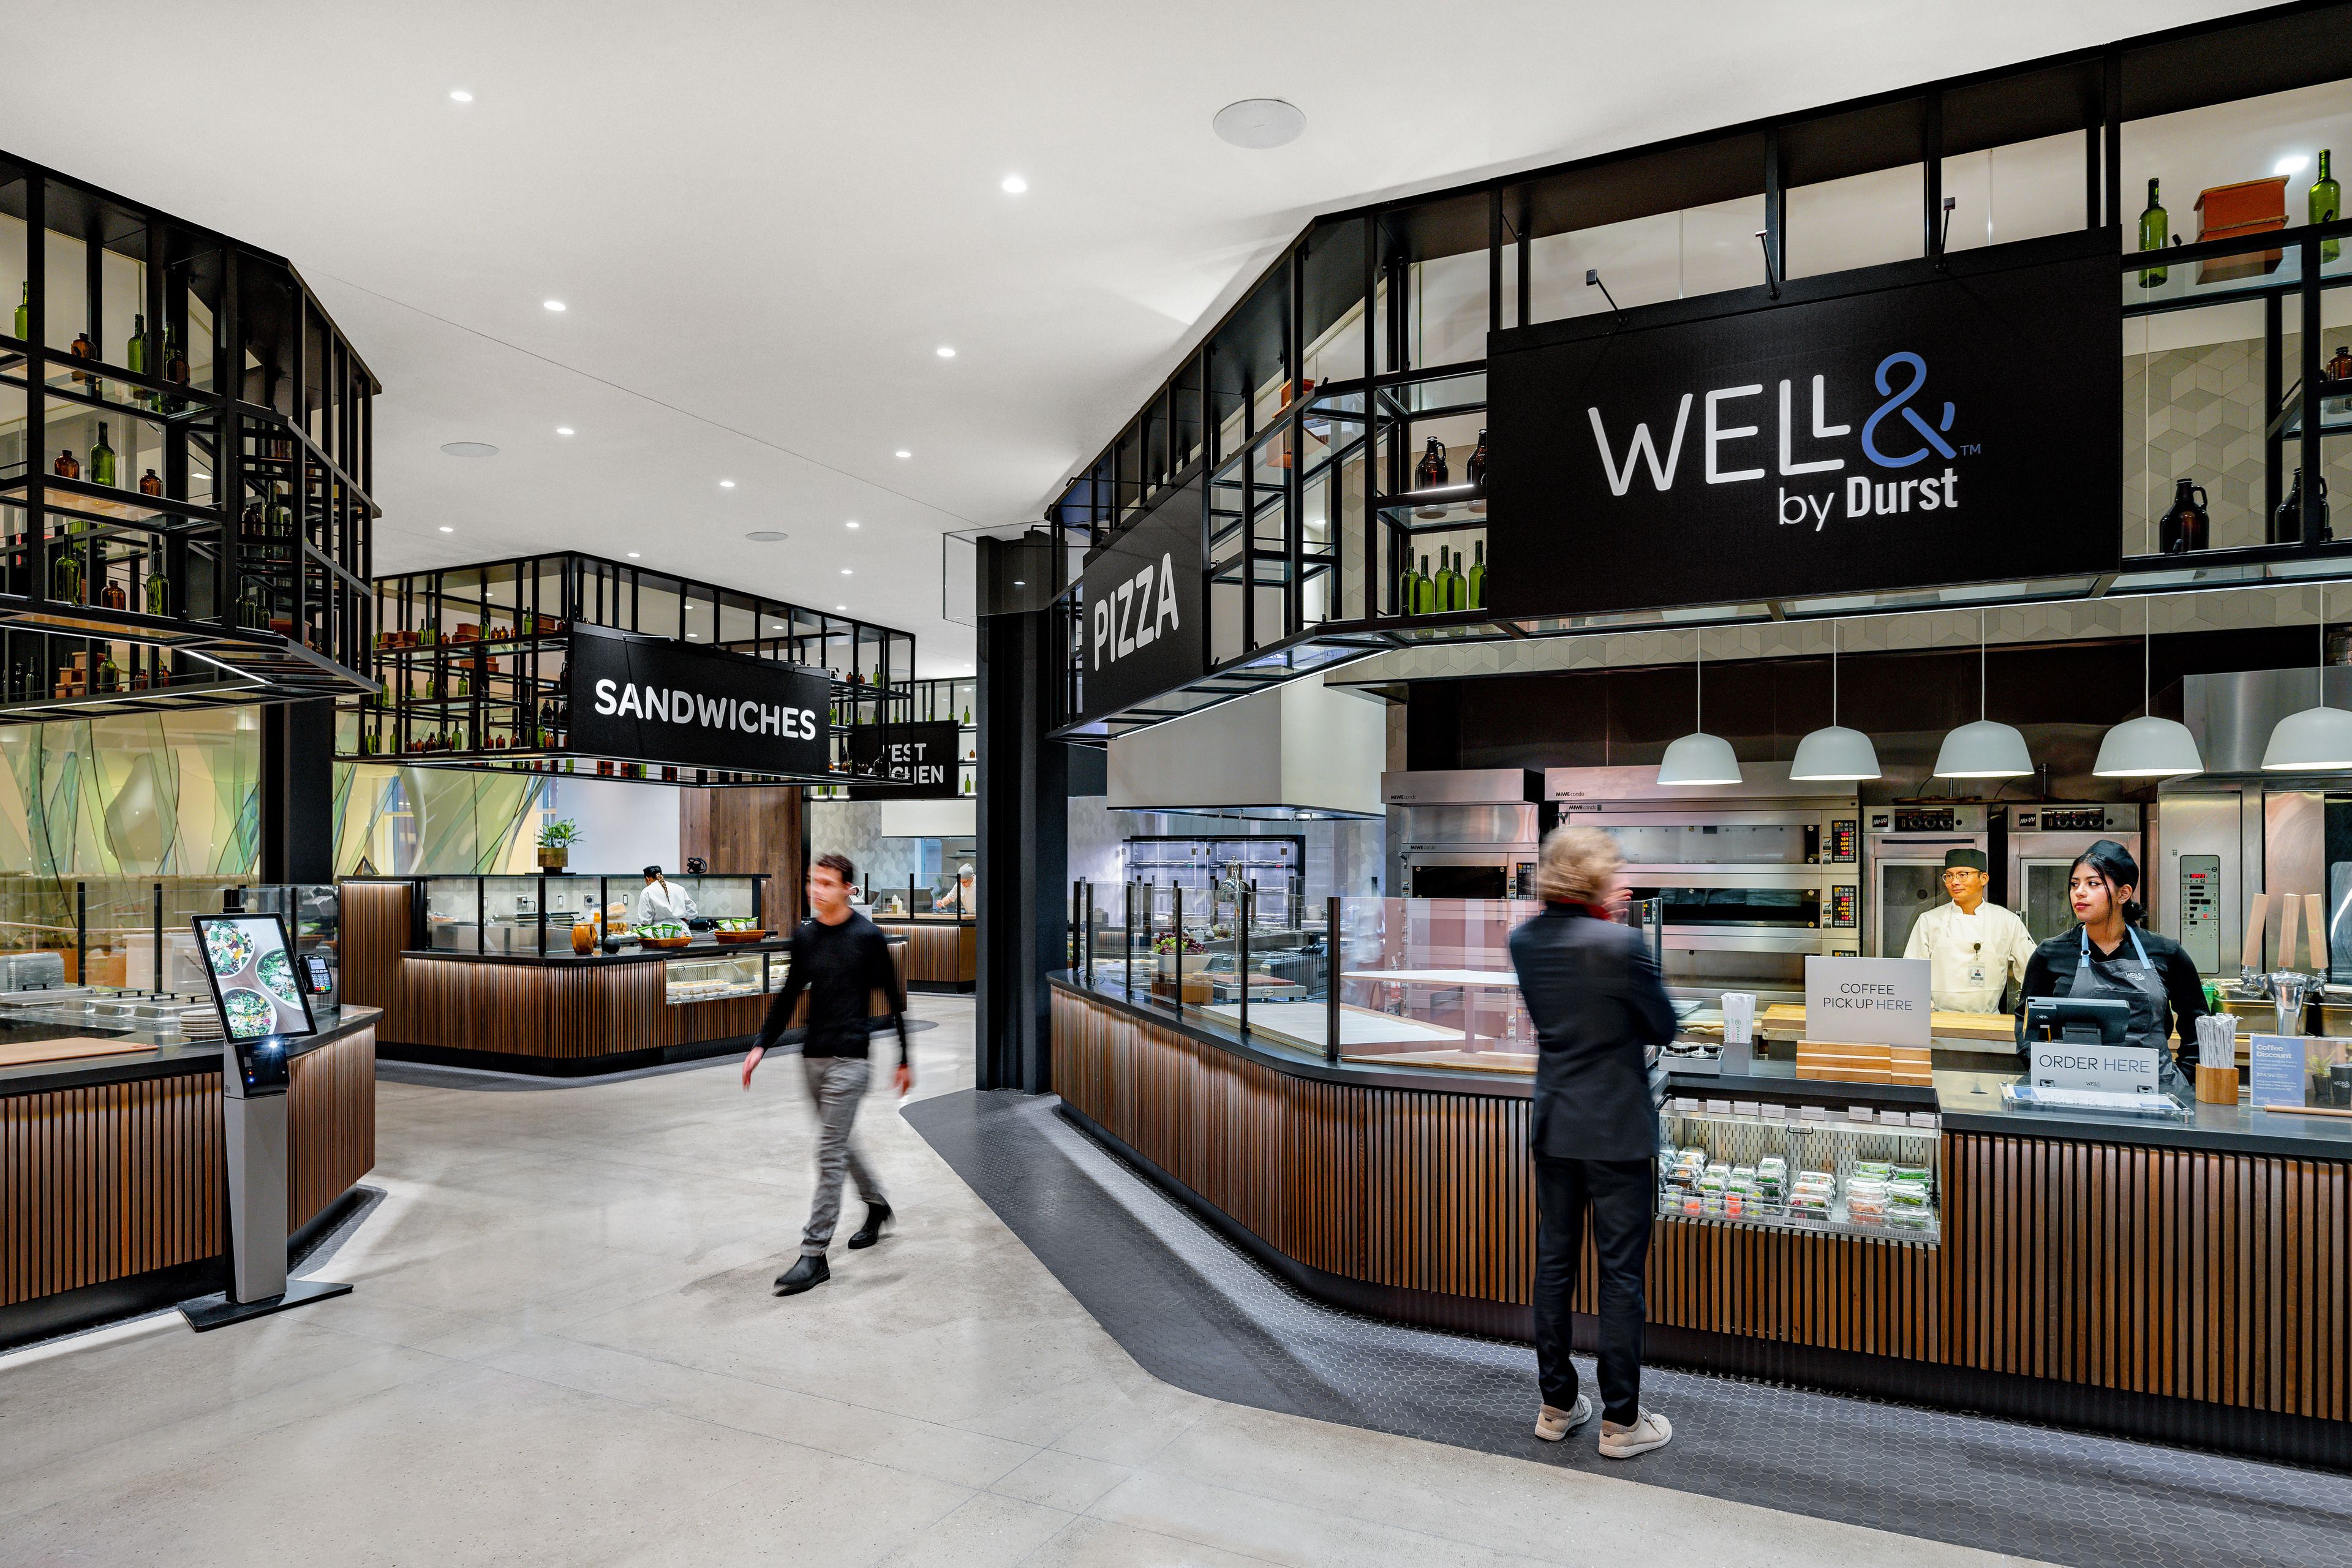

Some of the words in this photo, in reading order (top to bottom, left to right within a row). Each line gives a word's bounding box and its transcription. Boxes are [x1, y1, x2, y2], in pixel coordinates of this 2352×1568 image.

[1779, 487, 1835, 532] by
[1847, 467, 1959, 518] Durst
[1095, 552, 1179, 671] PIZZA
[595, 679, 816, 741] SANDWICHES
[883, 742, 927, 762] EST
[1841, 983, 1895, 995] COFFEE
[1823, 997, 1853, 1009] PICK
[1855, 999, 1874, 1009] UP
[1876, 999, 1913, 1011] HERE
[2039, 1055, 2098, 1070] ORDER
[2104, 1058, 2150, 1073] HERE
[2256, 1050, 2293, 1059] Discount
